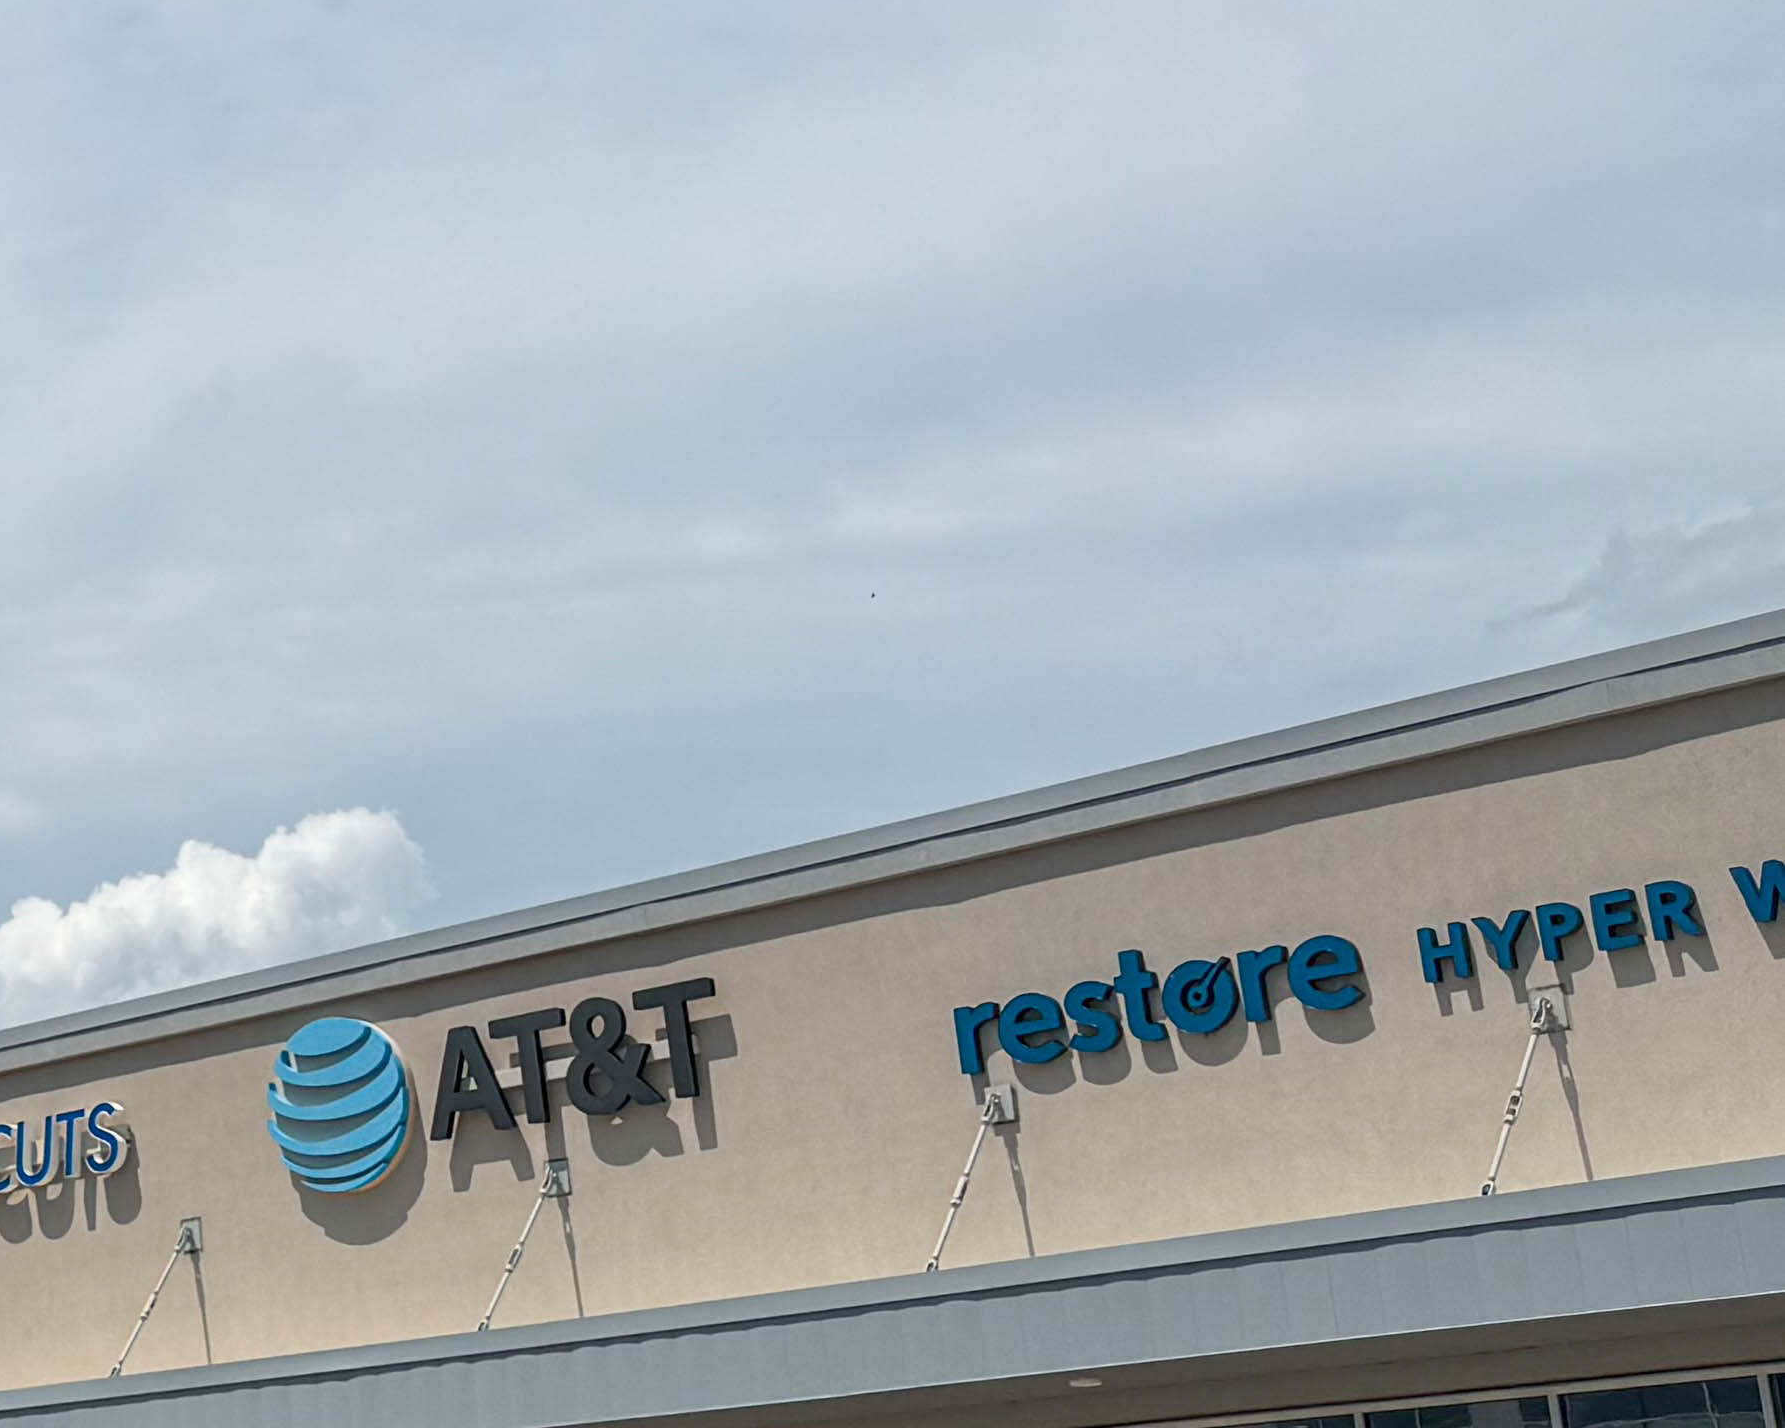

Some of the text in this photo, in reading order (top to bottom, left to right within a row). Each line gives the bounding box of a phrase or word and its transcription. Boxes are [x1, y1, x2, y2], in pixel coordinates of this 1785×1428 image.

[428, 976, 716, 1142] AT&T
[952, 932, 1367, 1077] restore
[1416, 879, 1707, 985] HYPER
